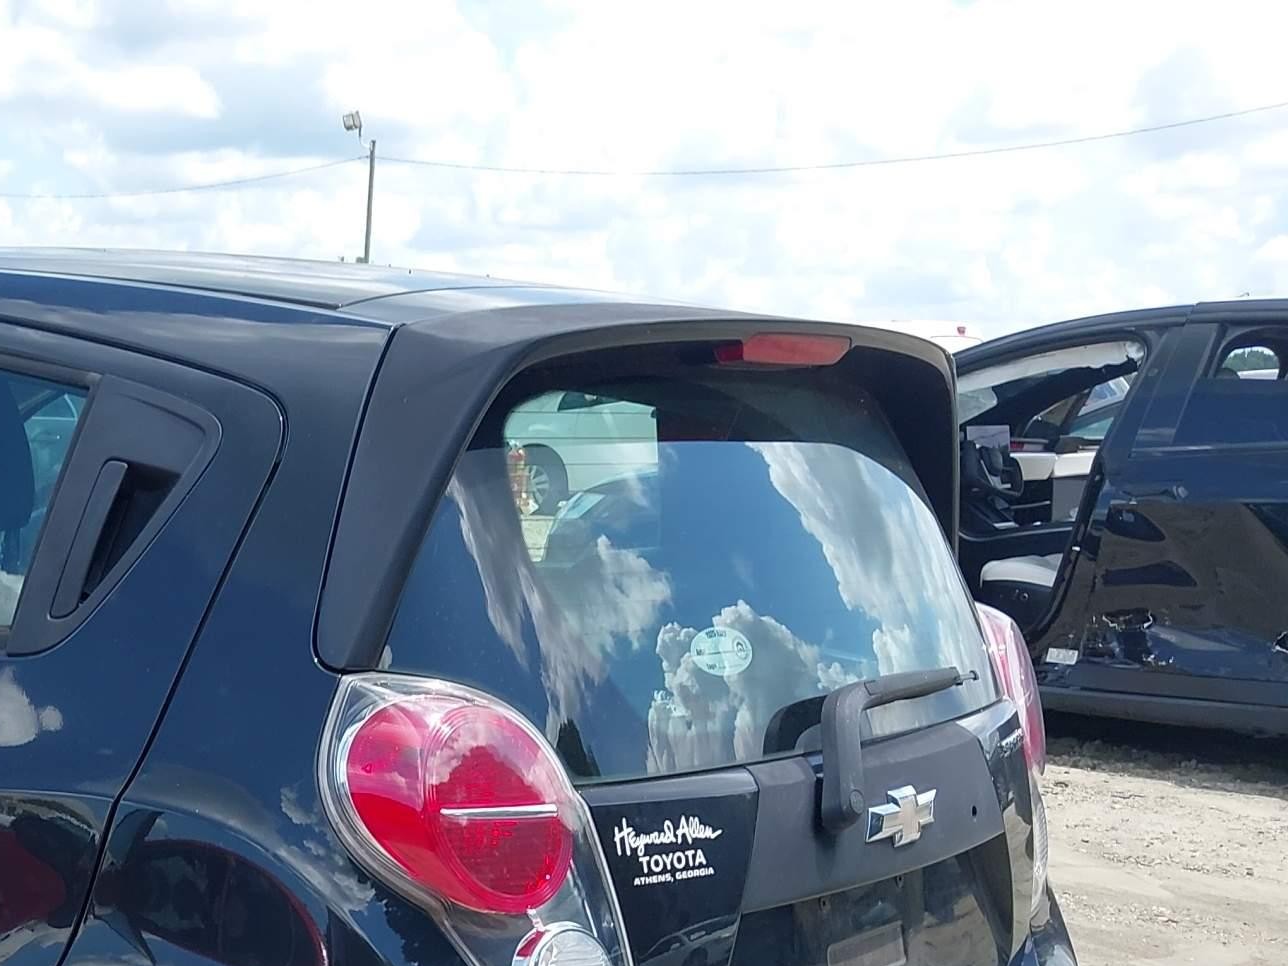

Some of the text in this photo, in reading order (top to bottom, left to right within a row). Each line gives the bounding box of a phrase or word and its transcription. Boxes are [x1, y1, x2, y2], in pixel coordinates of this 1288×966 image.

[675, 815, 723, 845] Allen
[638, 848, 707, 874] TOYOTA
[633, 866, 715, 886] ATHENS, GEORGIA
